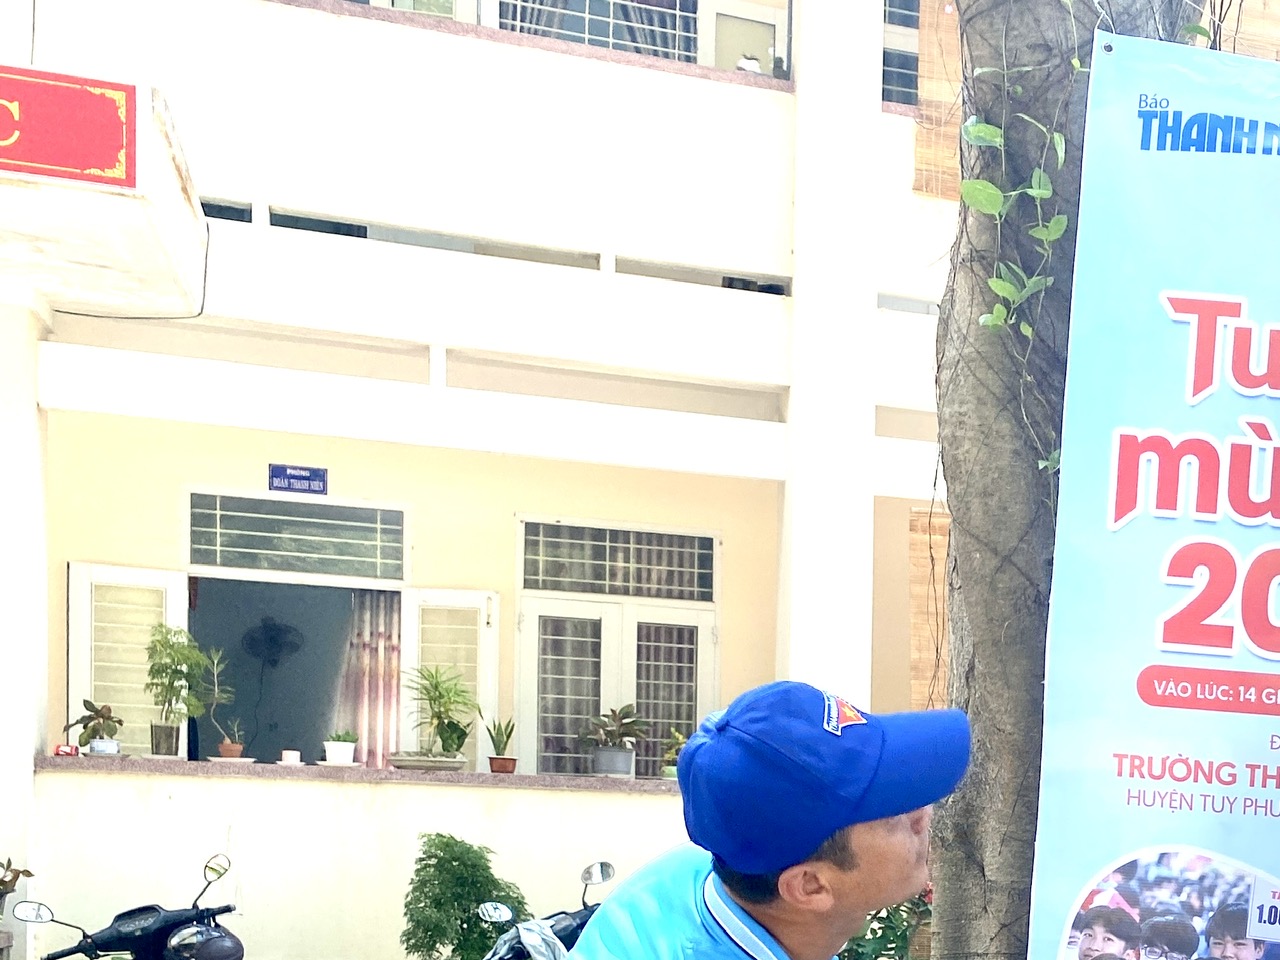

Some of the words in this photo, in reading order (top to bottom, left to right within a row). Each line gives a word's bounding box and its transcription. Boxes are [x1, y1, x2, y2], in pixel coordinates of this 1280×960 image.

[1138, 93, 1170, 109] Báo
[1137, 110, 1259, 154] THANH
[1153, 678, 1192, 698] VÀO
[1196, 681, 1234, 701] LÚC:
[1238, 685, 1257, 703] 14
[1113, 753, 1237, 786] TRƯỜNG
[1127, 788, 1194, 813] HUYỆN
[1200, 794, 1238, 814] TUY
